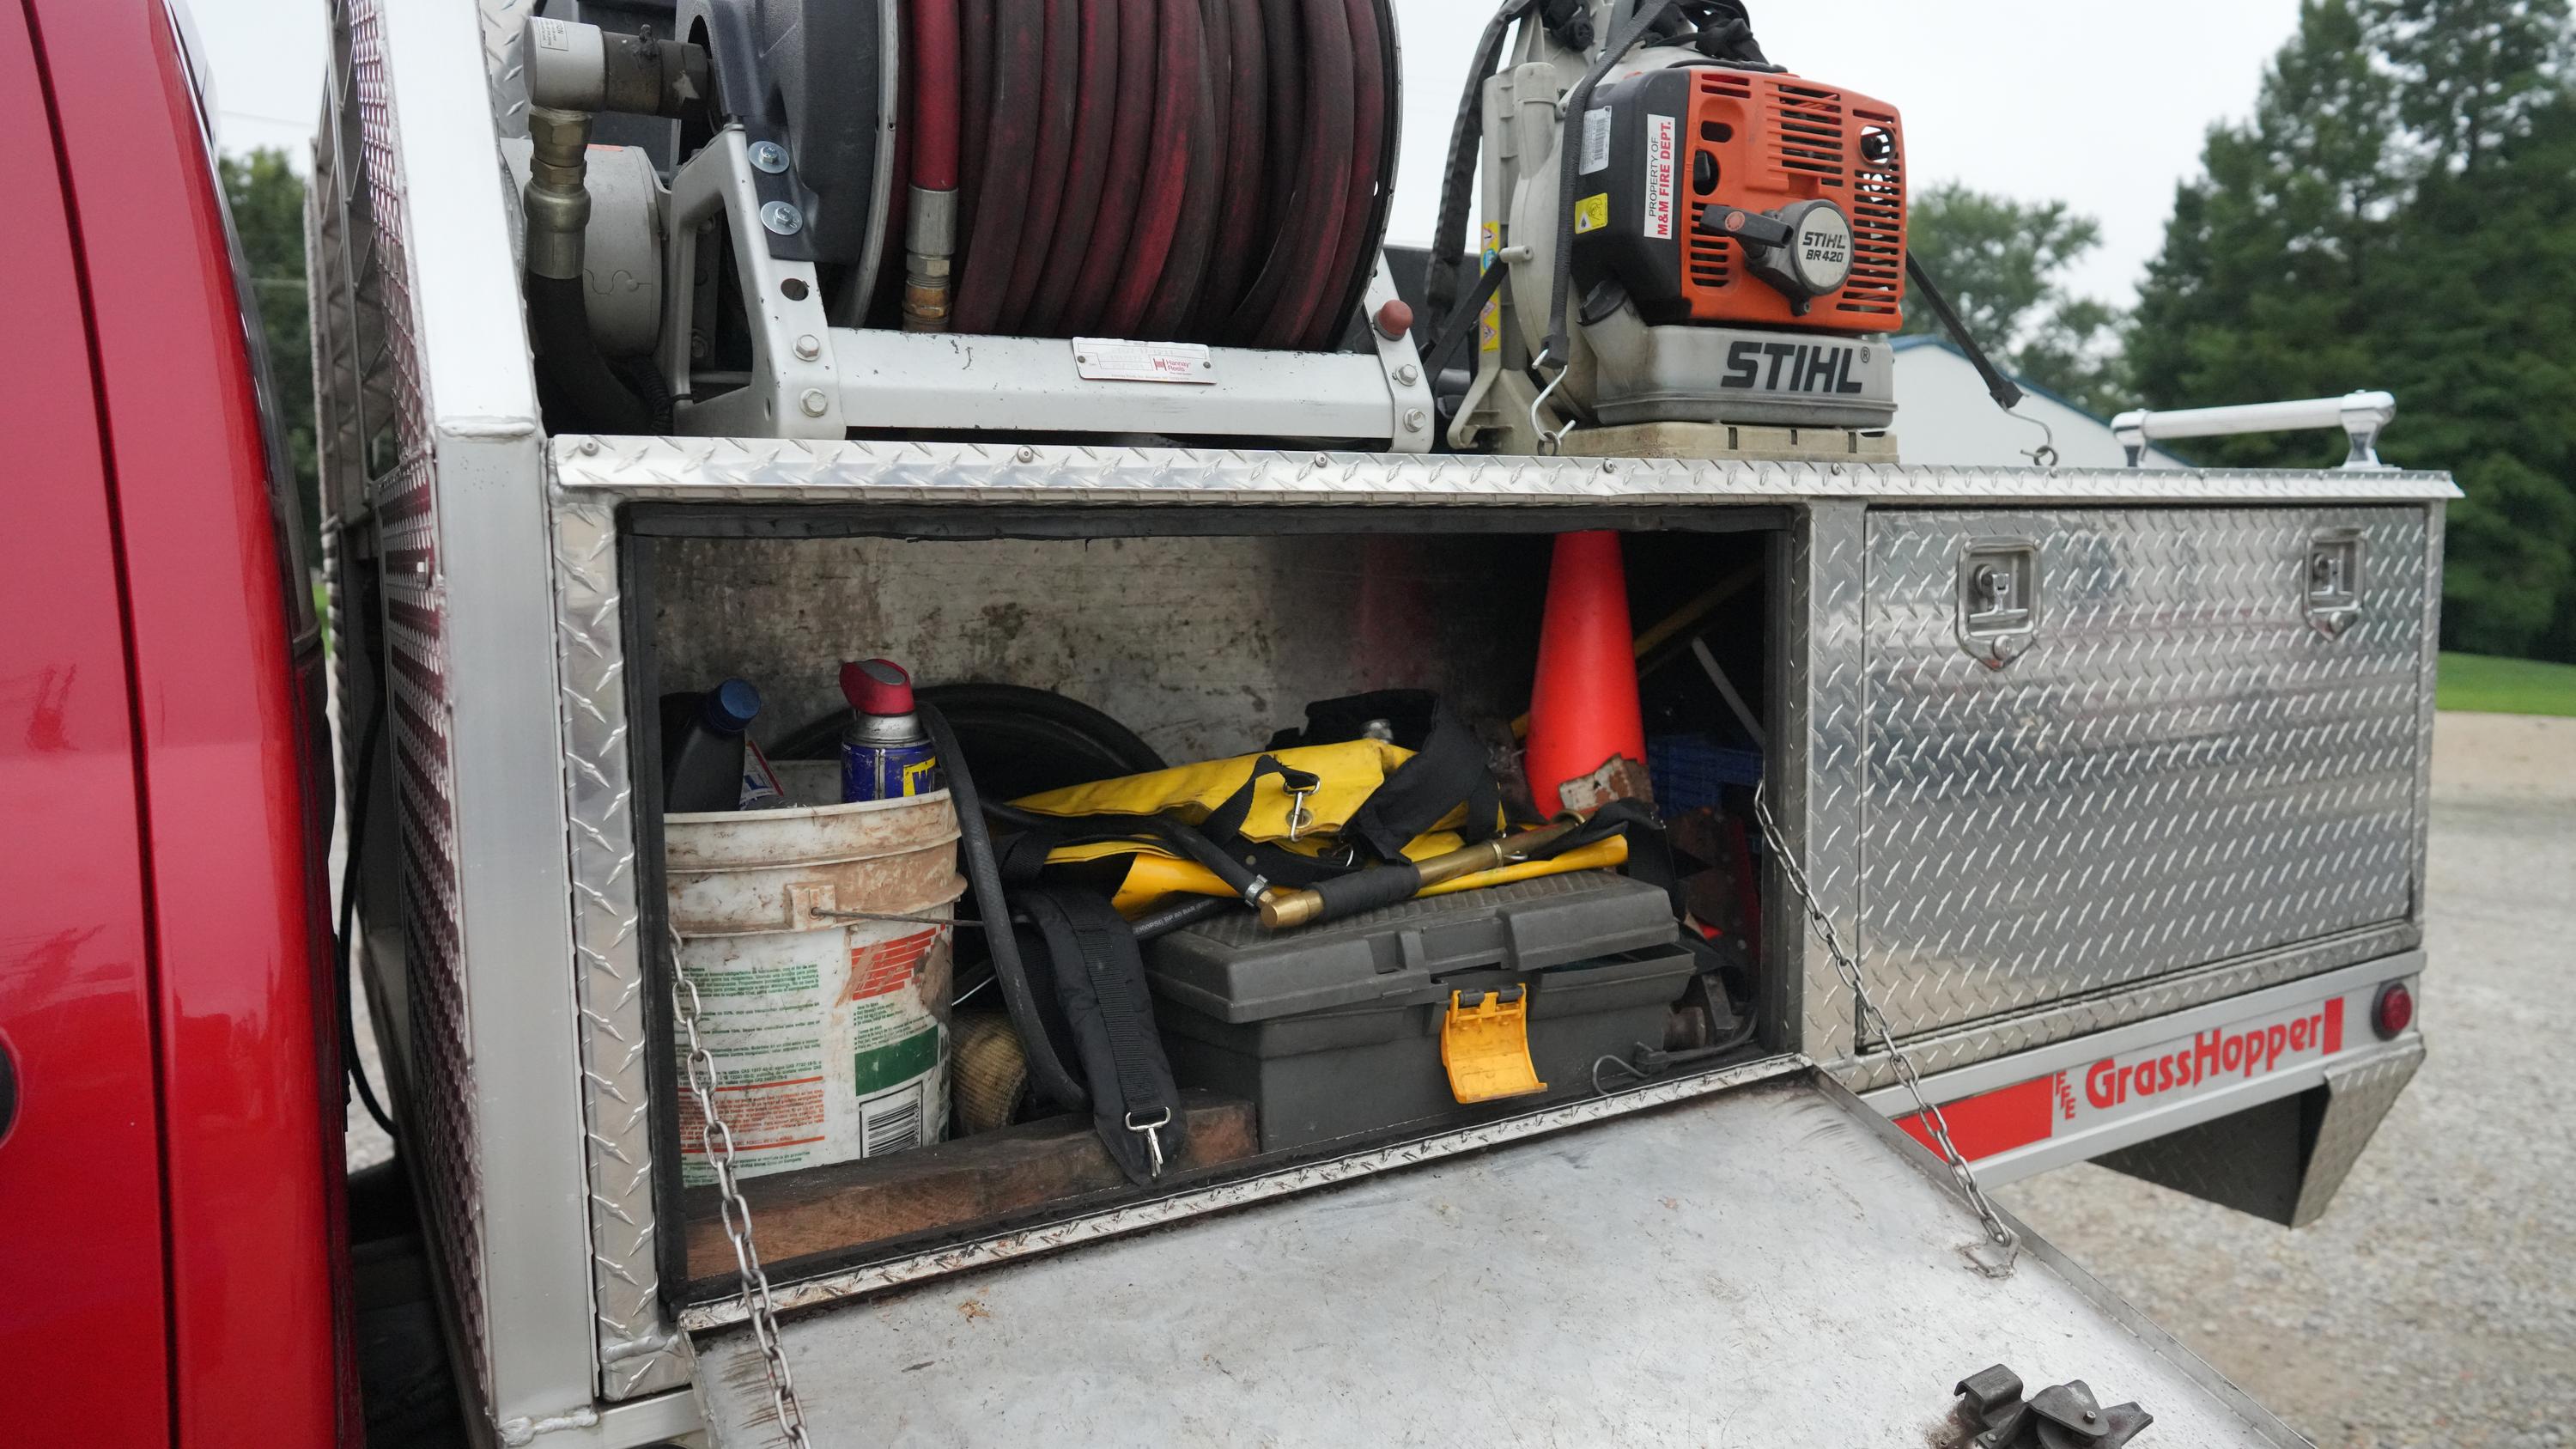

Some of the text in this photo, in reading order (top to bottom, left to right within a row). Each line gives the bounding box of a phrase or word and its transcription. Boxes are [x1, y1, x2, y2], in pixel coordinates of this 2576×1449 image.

[1649, 137, 1659, 217] PROPERTY OF
[1657, 121, 1672, 236] M&M FIRE DEPT.
[1802, 231, 1845, 249] STIHL
[1806, 249, 1844, 263] BR 420
[1166, 359, 1190, 369] Hannay
[1721, 340, 1863, 393] STIHL
[2085, 1012, 2324, 1109] GrassHopper
